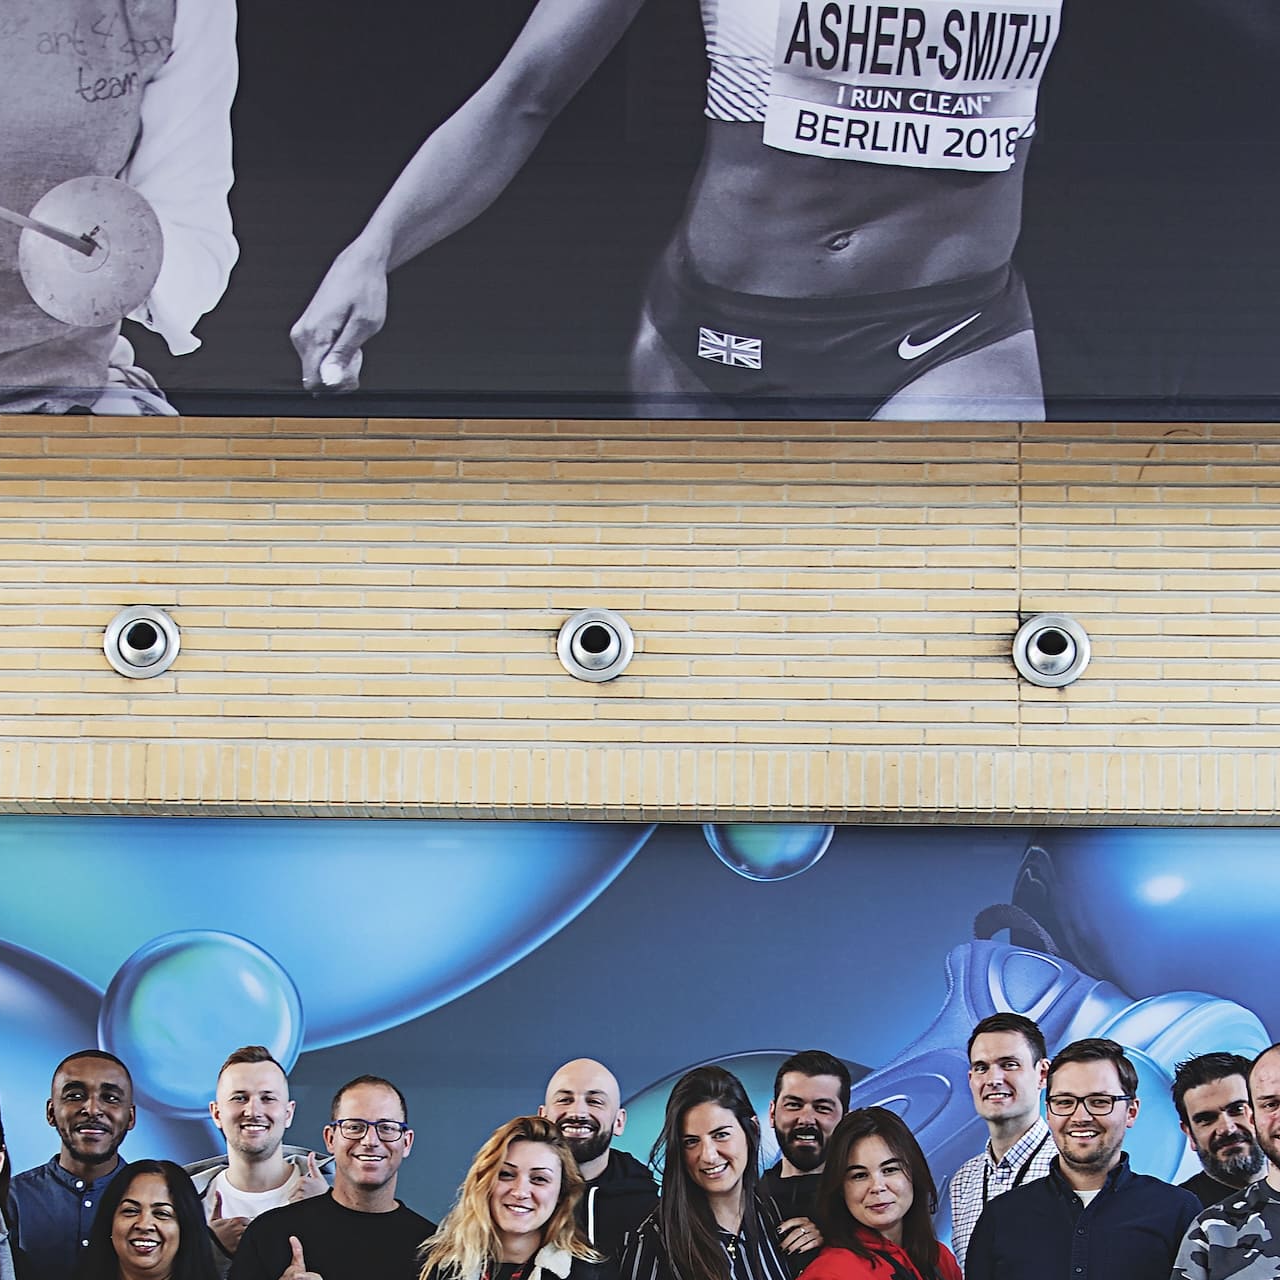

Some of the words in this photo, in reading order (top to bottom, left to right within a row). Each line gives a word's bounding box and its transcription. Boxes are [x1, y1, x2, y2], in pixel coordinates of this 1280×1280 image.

[783, 1, 1052, 81] ASHER-SMITH
[836, 86, 845, 105] I
[850, 89, 902, 110] RUN
[794, 109, 930, 155] BERLIN
[942, 127, 1020, 159] 2018
